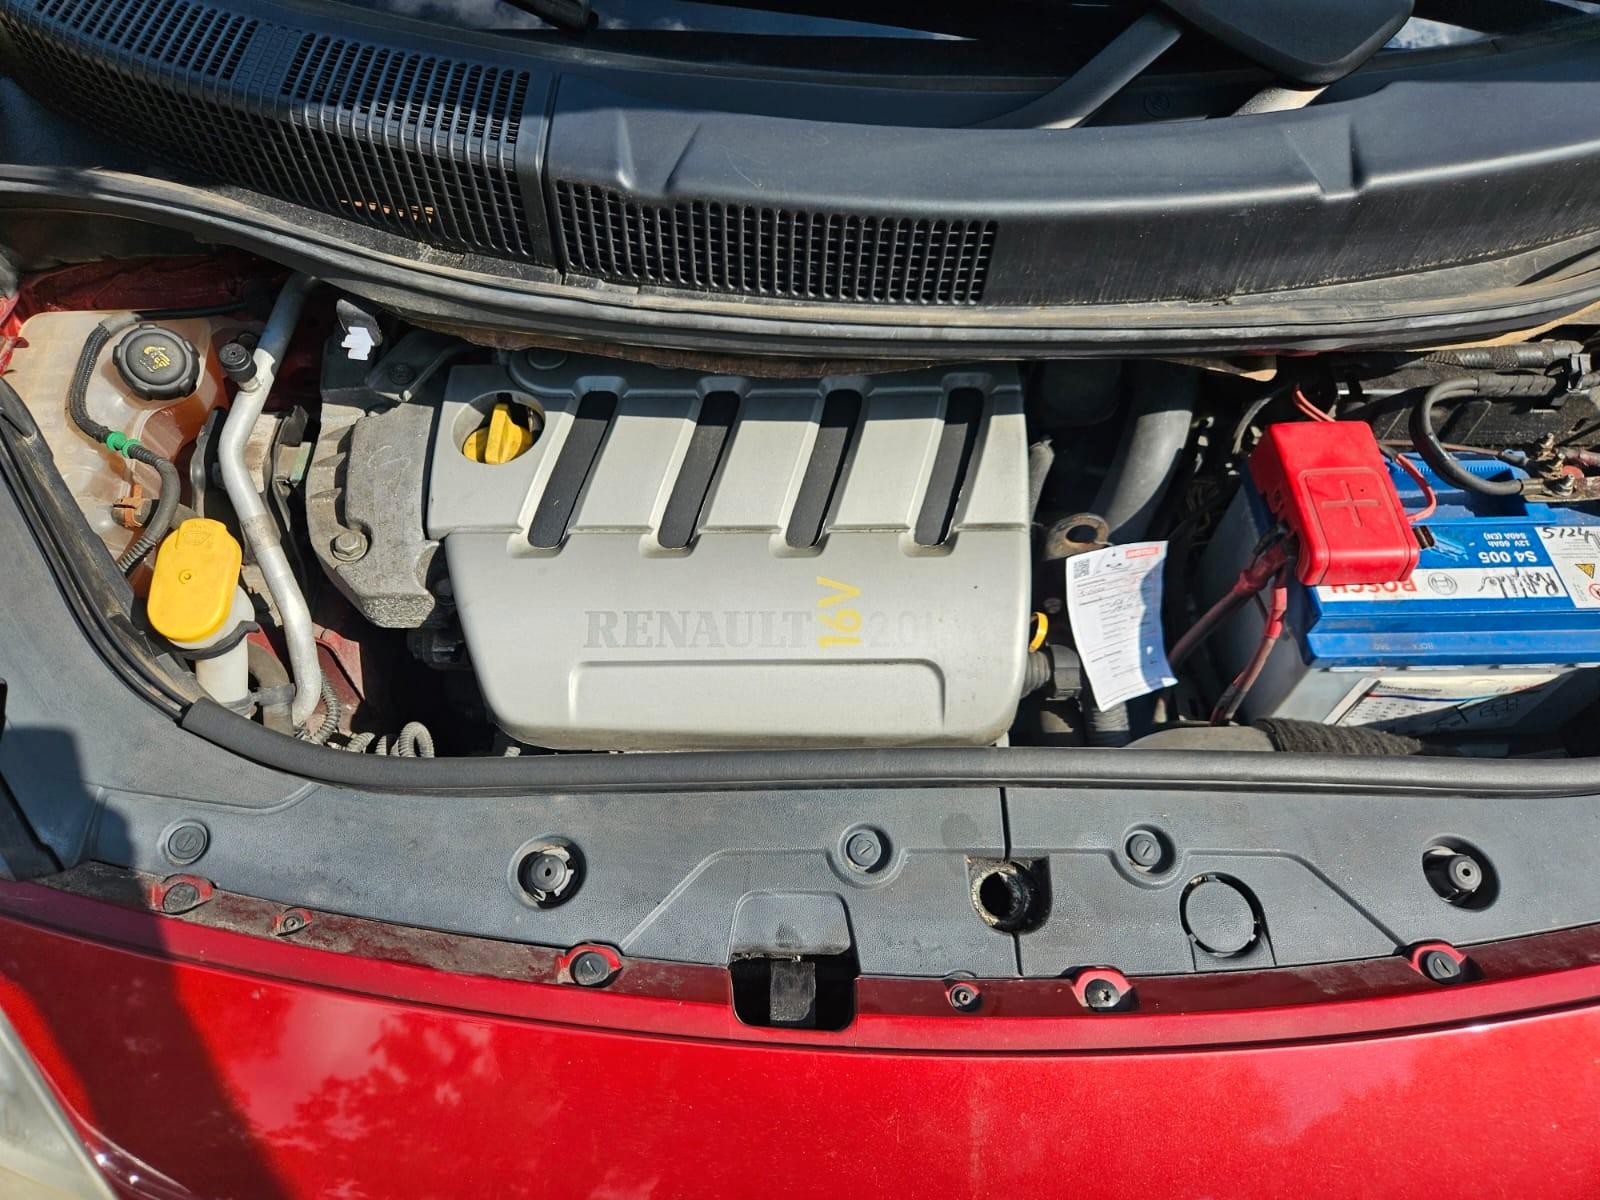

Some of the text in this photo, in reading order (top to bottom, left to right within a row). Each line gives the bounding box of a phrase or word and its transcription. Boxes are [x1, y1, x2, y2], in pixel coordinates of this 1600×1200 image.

[1478, 550, 1537, 564] S4 005
[583, 610, 812, 648] RENAULT
[816, 575, 863, 649] 16V
